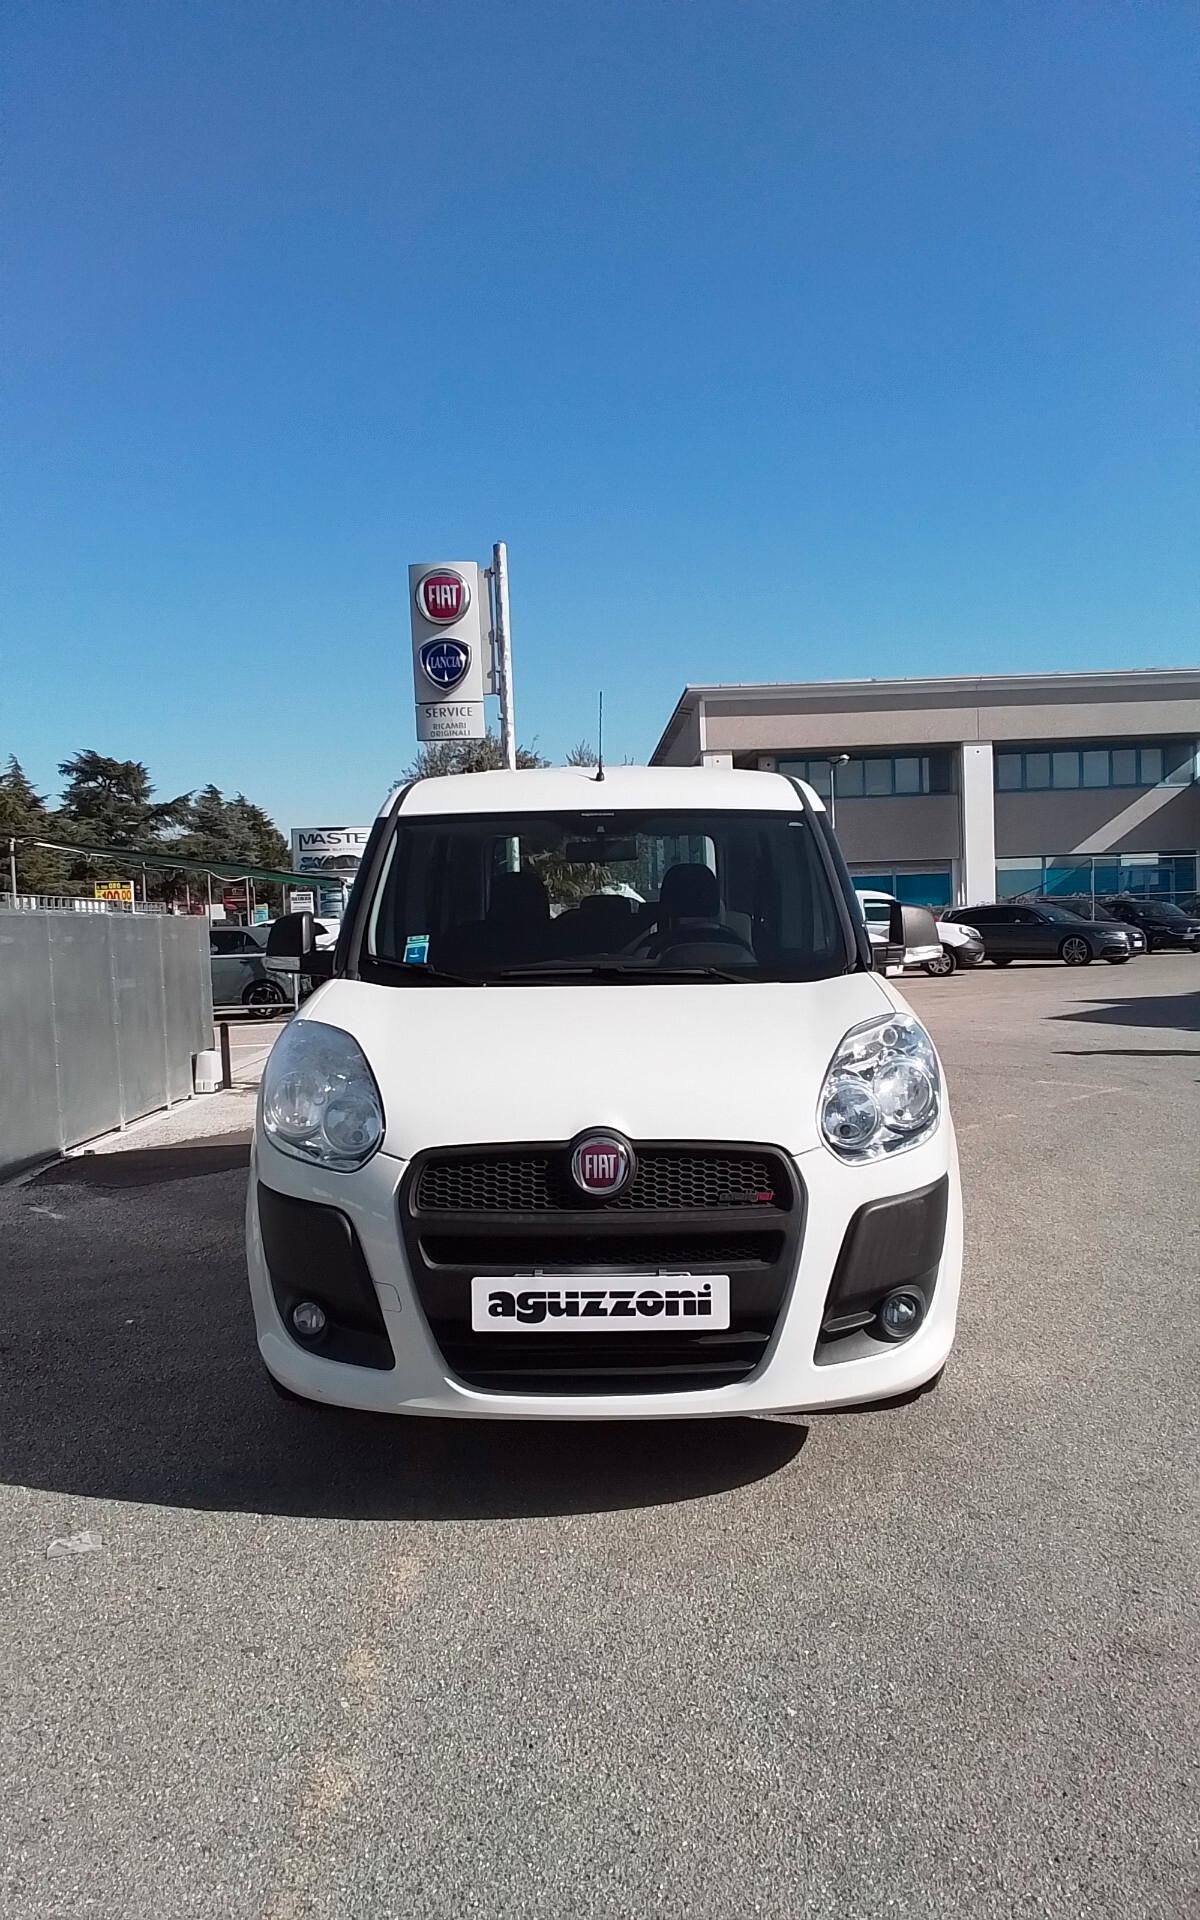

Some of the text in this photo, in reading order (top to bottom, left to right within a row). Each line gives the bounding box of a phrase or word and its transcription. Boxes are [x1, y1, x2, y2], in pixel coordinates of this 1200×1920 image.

[428, 584, 459, 609] FIAT
[430, 655, 461, 669] LANCIA
[425, 706, 473, 719] SERVICE
[432, 722, 467, 730] RICAMBI
[430, 729, 471, 738] ORIGINALI
[585, 1154, 617, 1179] FIAT
[487, 1283, 713, 1324] aguzzoni
